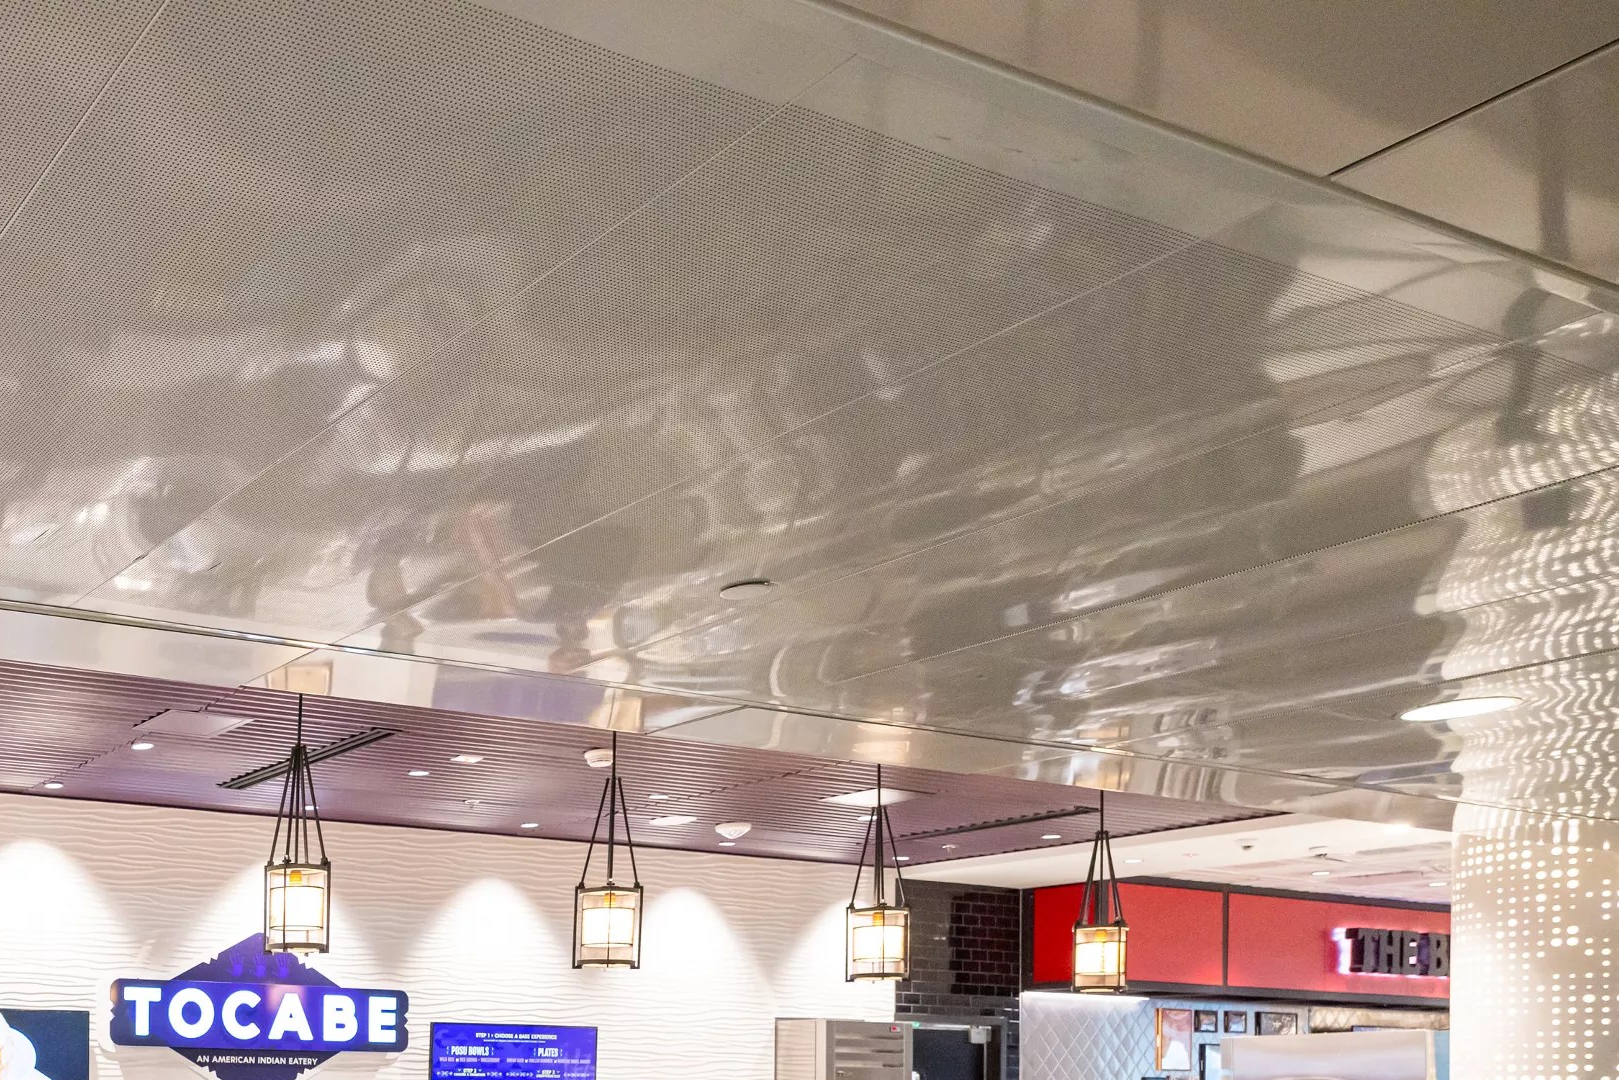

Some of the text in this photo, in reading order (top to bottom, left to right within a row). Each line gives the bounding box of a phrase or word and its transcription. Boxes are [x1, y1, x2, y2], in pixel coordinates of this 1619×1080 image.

[1331, 927, 1420, 976] THE
[124, 986, 397, 1043] TOCABE
[451, 1046, 489, 1056] POSU BOWLS
[538, 1048, 559, 1057] PLATES
[197, 1055, 318, 1066] AN AMERICAN INDIAN EATERY
